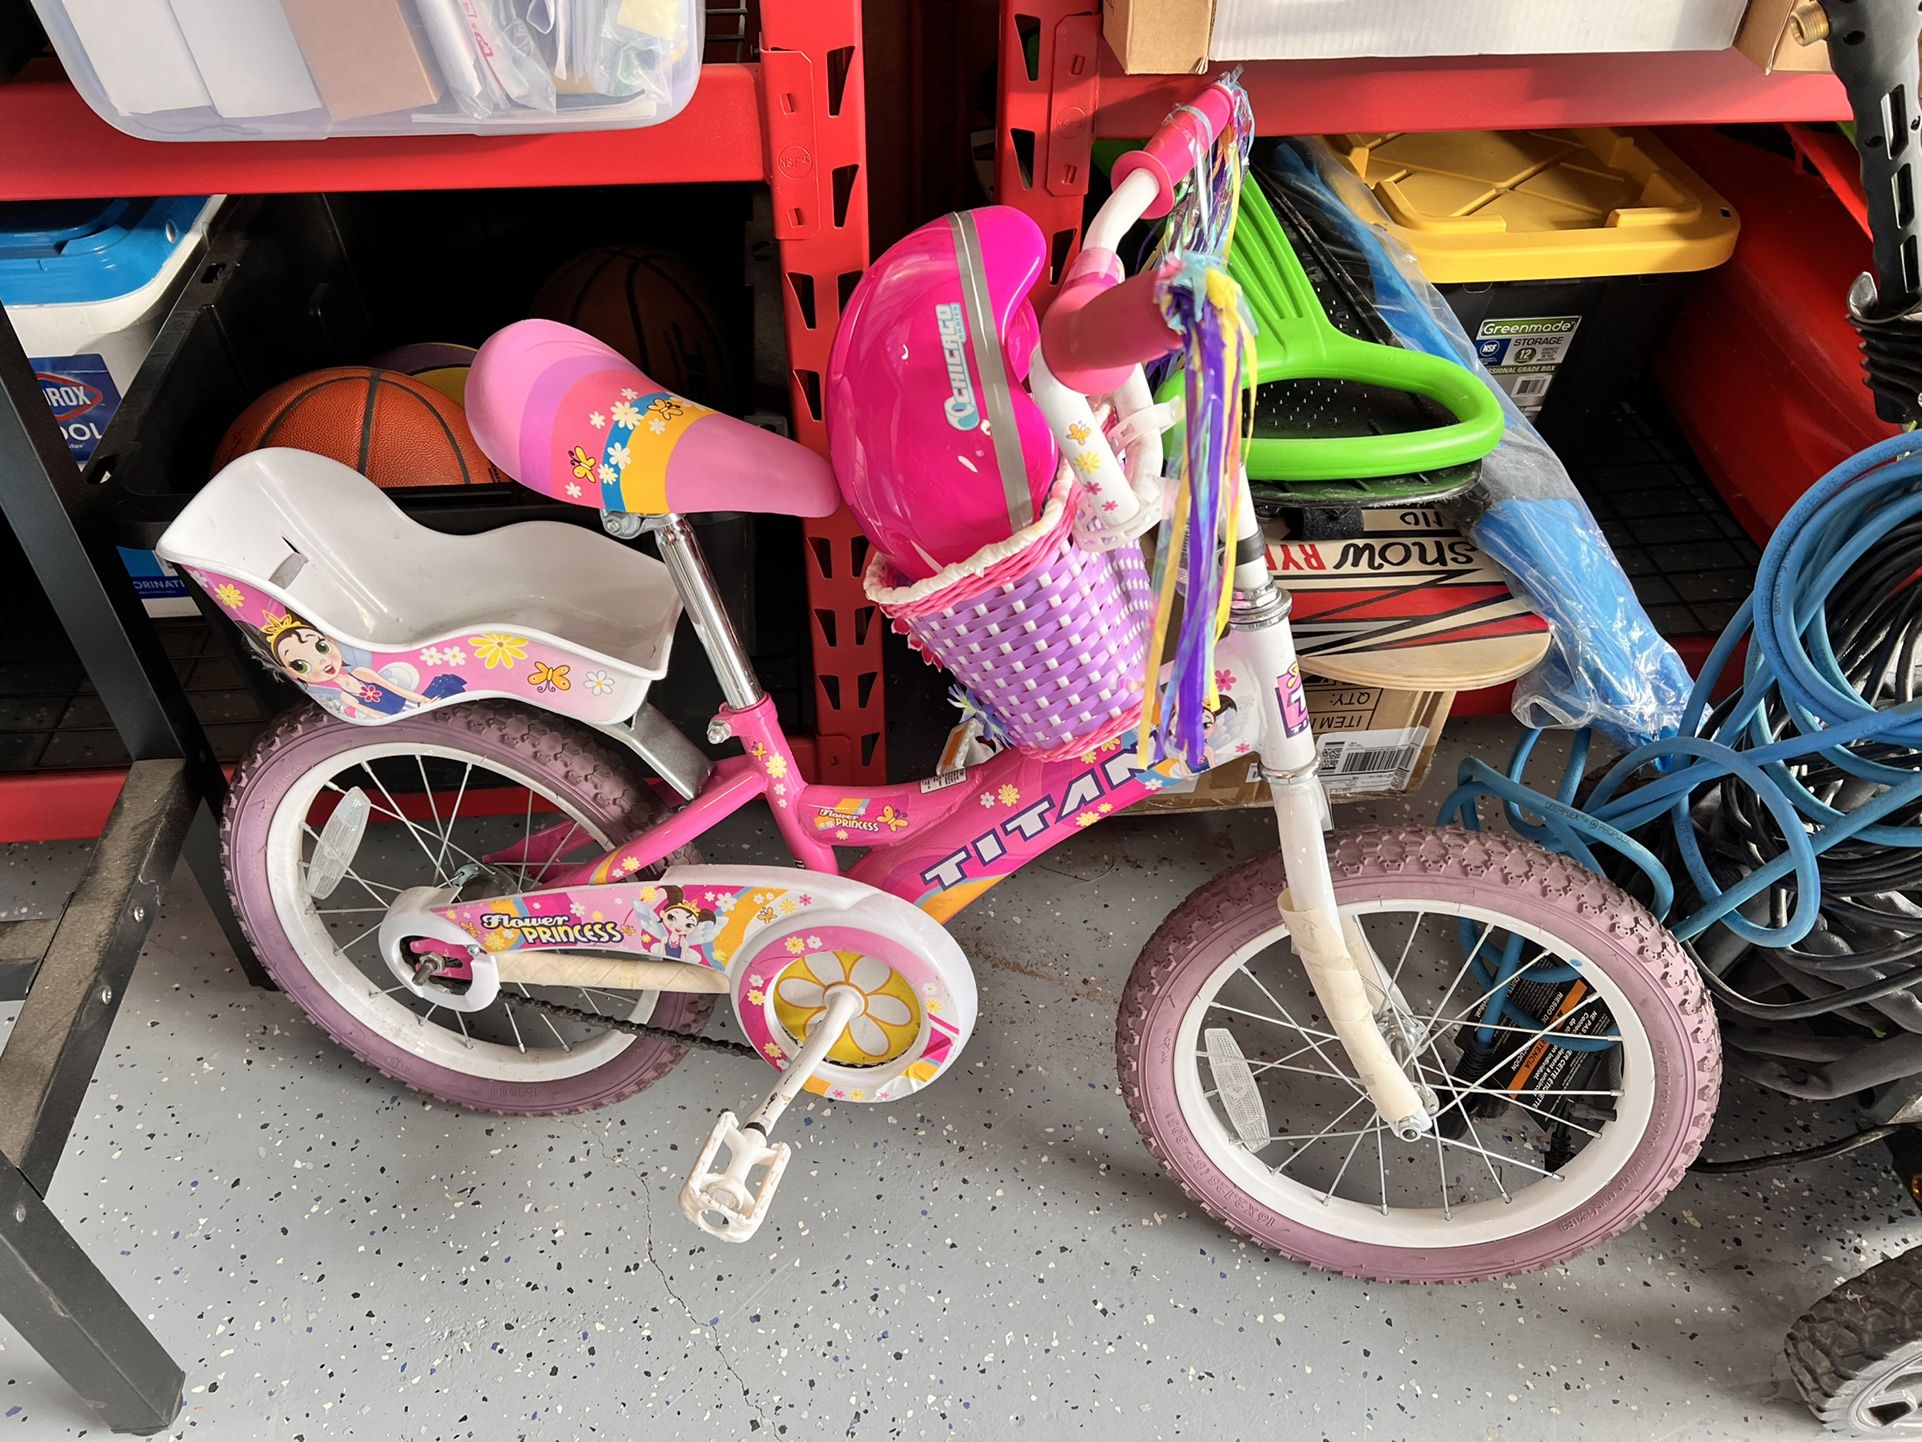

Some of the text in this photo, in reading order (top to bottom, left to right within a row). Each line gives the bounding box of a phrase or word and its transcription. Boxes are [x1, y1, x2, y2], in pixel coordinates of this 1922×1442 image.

[1483, 320, 1572, 335] Greenmade
[1482, 344, 1498, 353] NSF
[1513, 336, 1564, 347] STORAGE
[936, 303, 972, 404] CHICAGO
[1519, 349, 1532, 359] 12
[1488, 366, 1516, 374] SSIONAL
[42, 386, 92, 407] ROX
[1330, 691, 1371, 706] QTY:
[1319, 715, 1363, 728] ITEM
[819, 808, 860, 820] Flower
[920, 738, 1163, 891] TITAN
[834, 817, 880, 832] PRINCESS
[478, 913, 570, 929] Flower
[520, 922, 625, 944] PRINCESS
[1545, 991, 1563, 1015] RIESGO
[1588, 1009, 1598, 1020] NE
[1580, 1018, 1592, 1033] PAS
[1549, 1057, 1566, 1079] CETTE
